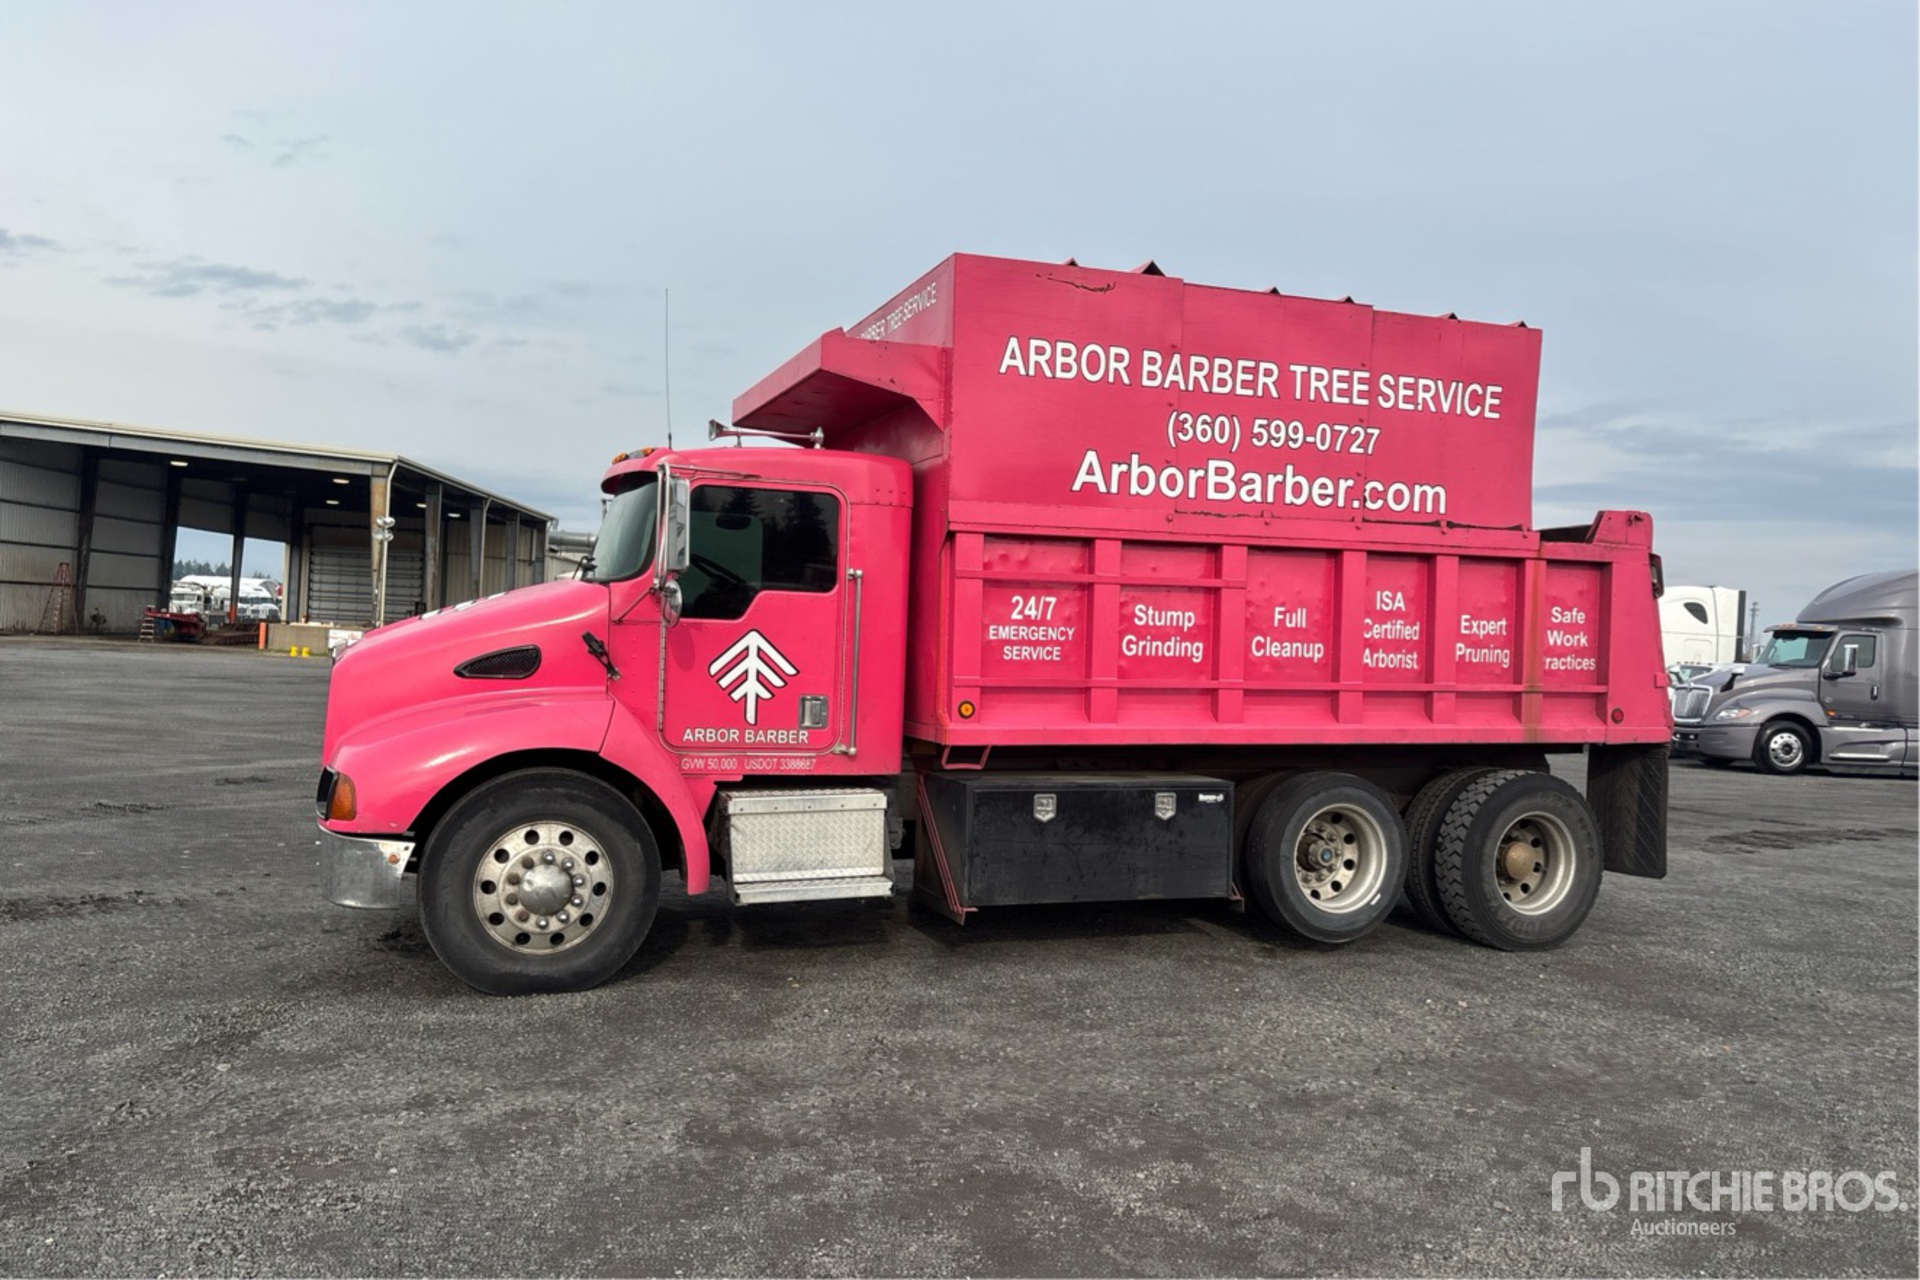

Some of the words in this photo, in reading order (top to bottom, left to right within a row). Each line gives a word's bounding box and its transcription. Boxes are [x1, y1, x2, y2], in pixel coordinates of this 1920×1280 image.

[886, 306, 902, 333] TREE
[903, 282, 936, 321] SERVICE
[999, 335, 1131, 386] ARBOR
[1140, 349, 1280, 399] BARBER
[1289, 364, 1371, 407] TREE
[1377, 373, 1504, 420] SERVICE
[1167, 411, 1242, 453] (360)
[1251, 418, 1382, 456] 599-0727
[1071, 449, 1448, 515] ArborBarber.com
[1010, 595, 1058, 621] 24/7
[1375, 590, 1406, 612] ISA
[1133, 603, 1196, 632] Stump
[1273, 606, 1307, 628] Full
[1460, 614, 1507, 638] Expert
[1550, 606, 1586, 625] Safe
[988, 624, 1076, 641] EMERGENCY
[1547, 629, 1588, 647] Work
[1003, 645, 1062, 661] SERVICE
[1121, 634, 1204, 663] Grinding
[1251, 635, 1324, 663] Cleanup
[1363, 647, 1419, 670] Arborist
[1455, 643, 1510, 668] Pruning
[1543, 654, 1596, 671] ractices
[682, 728, 740, 743] ARBOR
[744, 729, 809, 744] BARBER
[682, 757, 706, 770] GVW
[744, 758, 778, 770] USDOT
